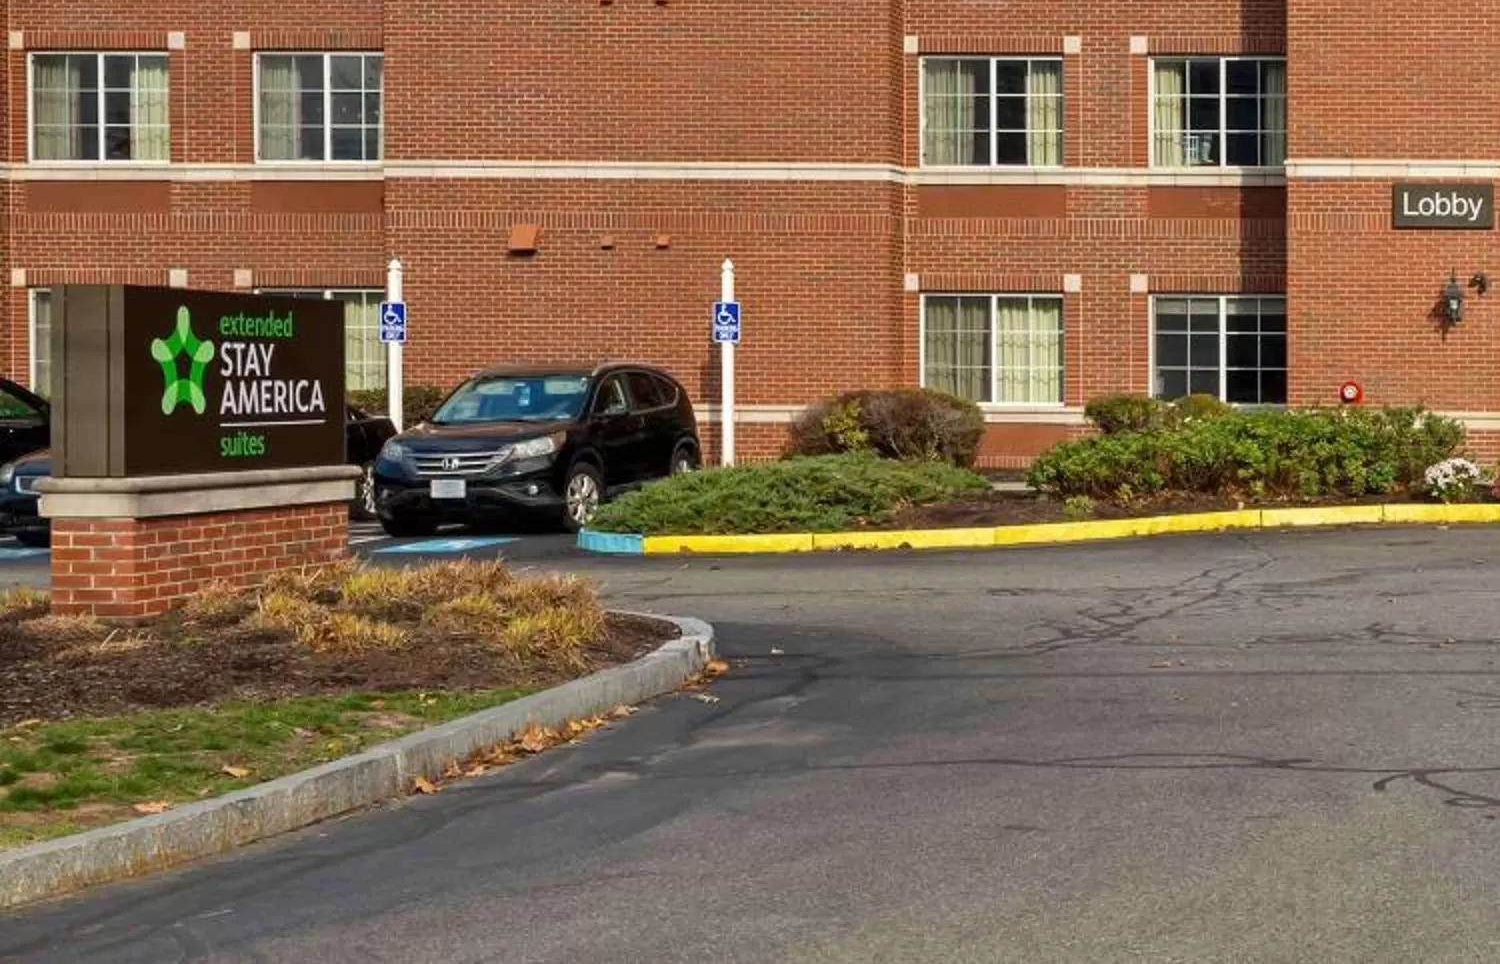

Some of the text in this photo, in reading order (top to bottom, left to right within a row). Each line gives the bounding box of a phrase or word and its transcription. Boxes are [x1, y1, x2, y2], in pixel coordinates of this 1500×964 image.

[1403, 191, 1483, 221] Lobby
[219, 310, 293, 337] extended
[219, 341, 275, 377] STAY
[219, 379, 325, 415] AMERICA
[220, 431, 265, 456] suites
